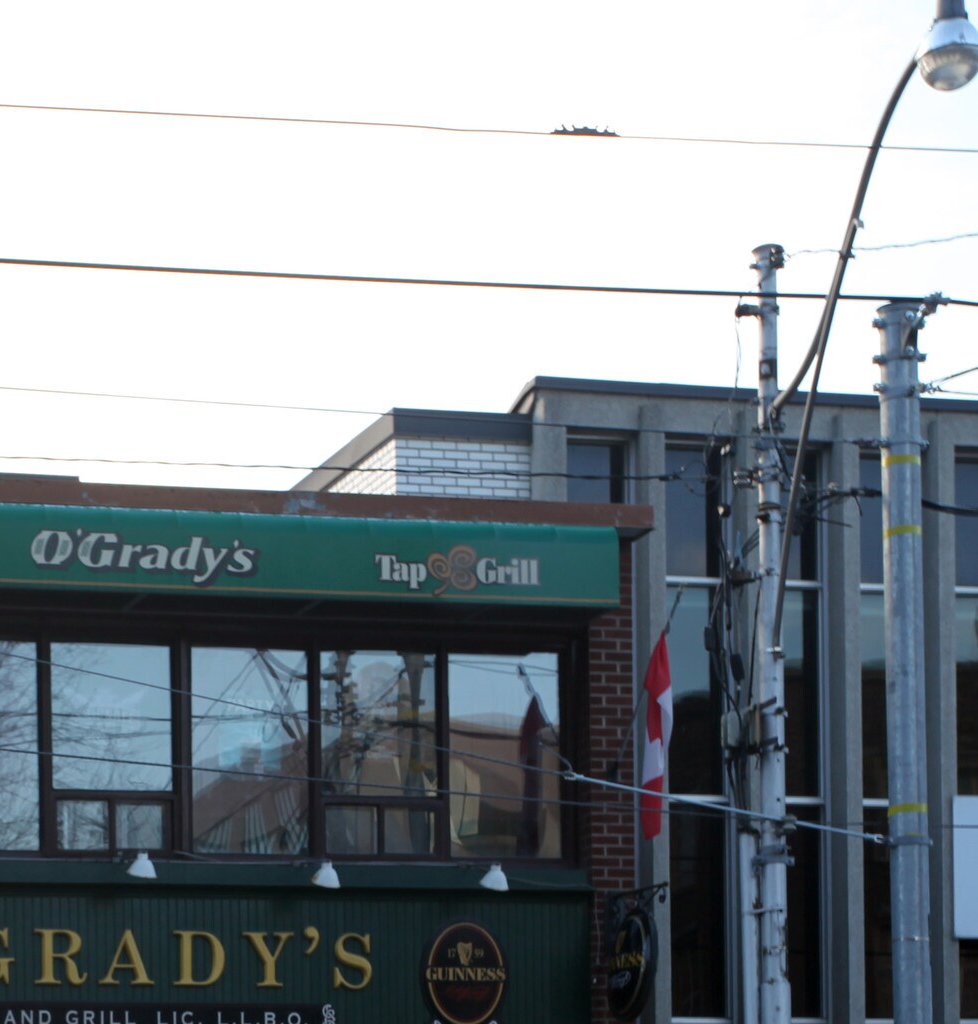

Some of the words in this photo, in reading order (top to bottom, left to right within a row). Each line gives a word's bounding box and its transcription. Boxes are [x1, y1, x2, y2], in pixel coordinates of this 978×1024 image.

[30, 527, 256, 584] O'Grady's
[375, 554, 427, 589] Tap
[476, 557, 541, 586] Grill
[425, 966, 507, 982] GUINNESS
